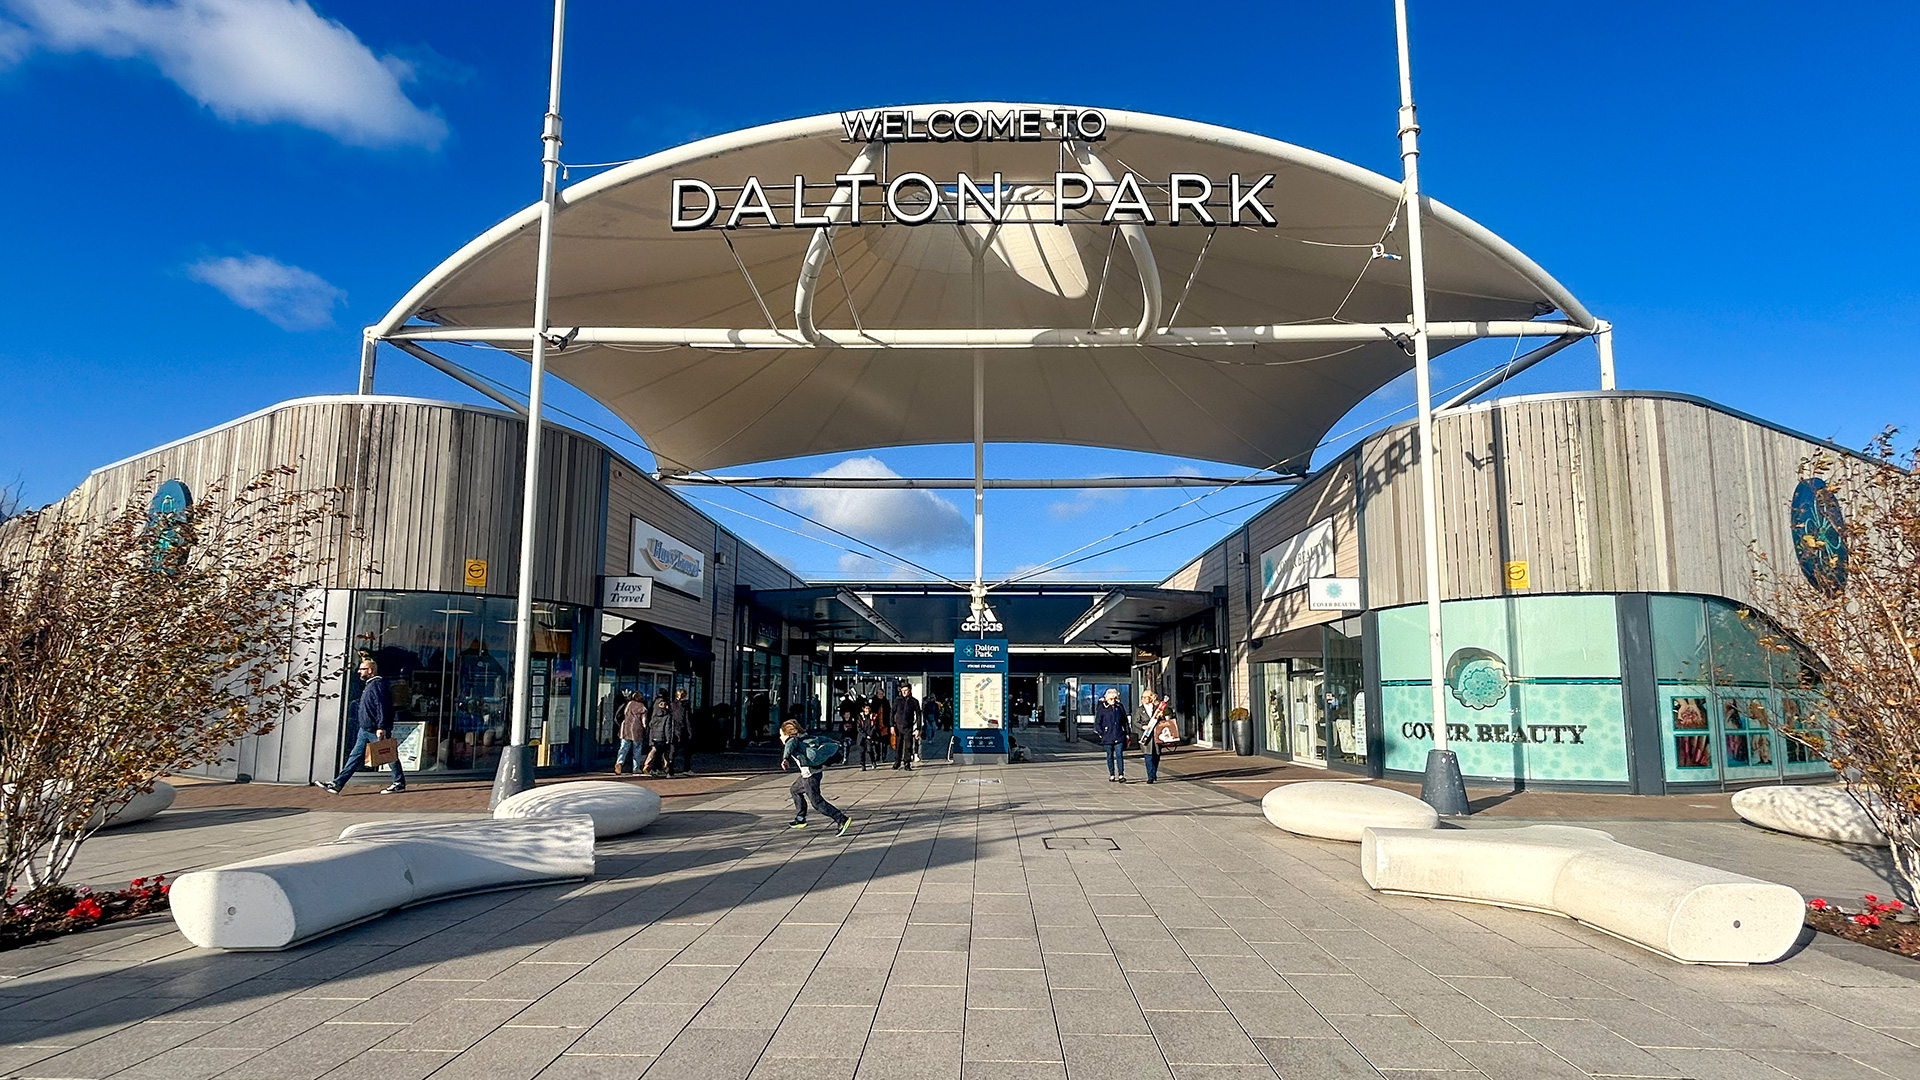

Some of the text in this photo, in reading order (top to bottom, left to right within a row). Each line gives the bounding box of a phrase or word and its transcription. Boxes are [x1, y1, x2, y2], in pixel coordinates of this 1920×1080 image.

[840, 109, 1107, 142] WELCOME TO
[671, 171, 1278, 231] DALTON PARK
[614, 581, 642, 594] Hays
[610, 592, 645, 603] Travel
[974, 644, 1000, 652] Dalton
[974, 650, 993, 658] Park
[1475, 723, 1587, 744] BEAUTY
